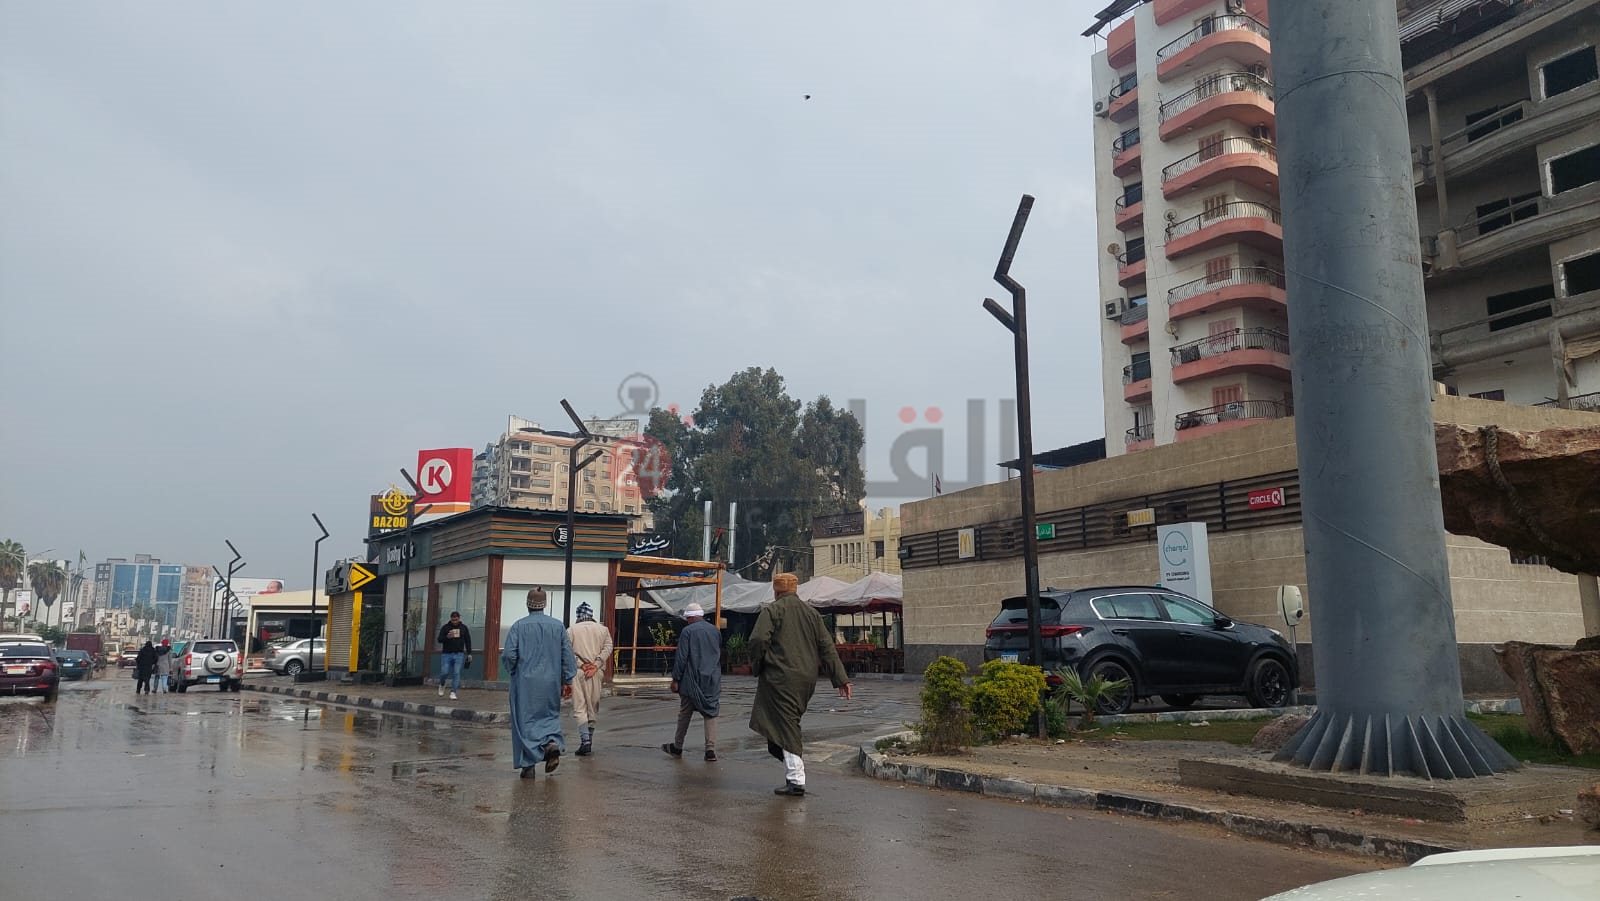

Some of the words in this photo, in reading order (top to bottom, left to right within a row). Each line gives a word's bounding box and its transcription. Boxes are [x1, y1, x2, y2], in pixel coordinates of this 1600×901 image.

[428, 465, 449, 492] K
[1250, 495, 1271, 505] CIRCLE
[1273, 491, 1280, 504] K
